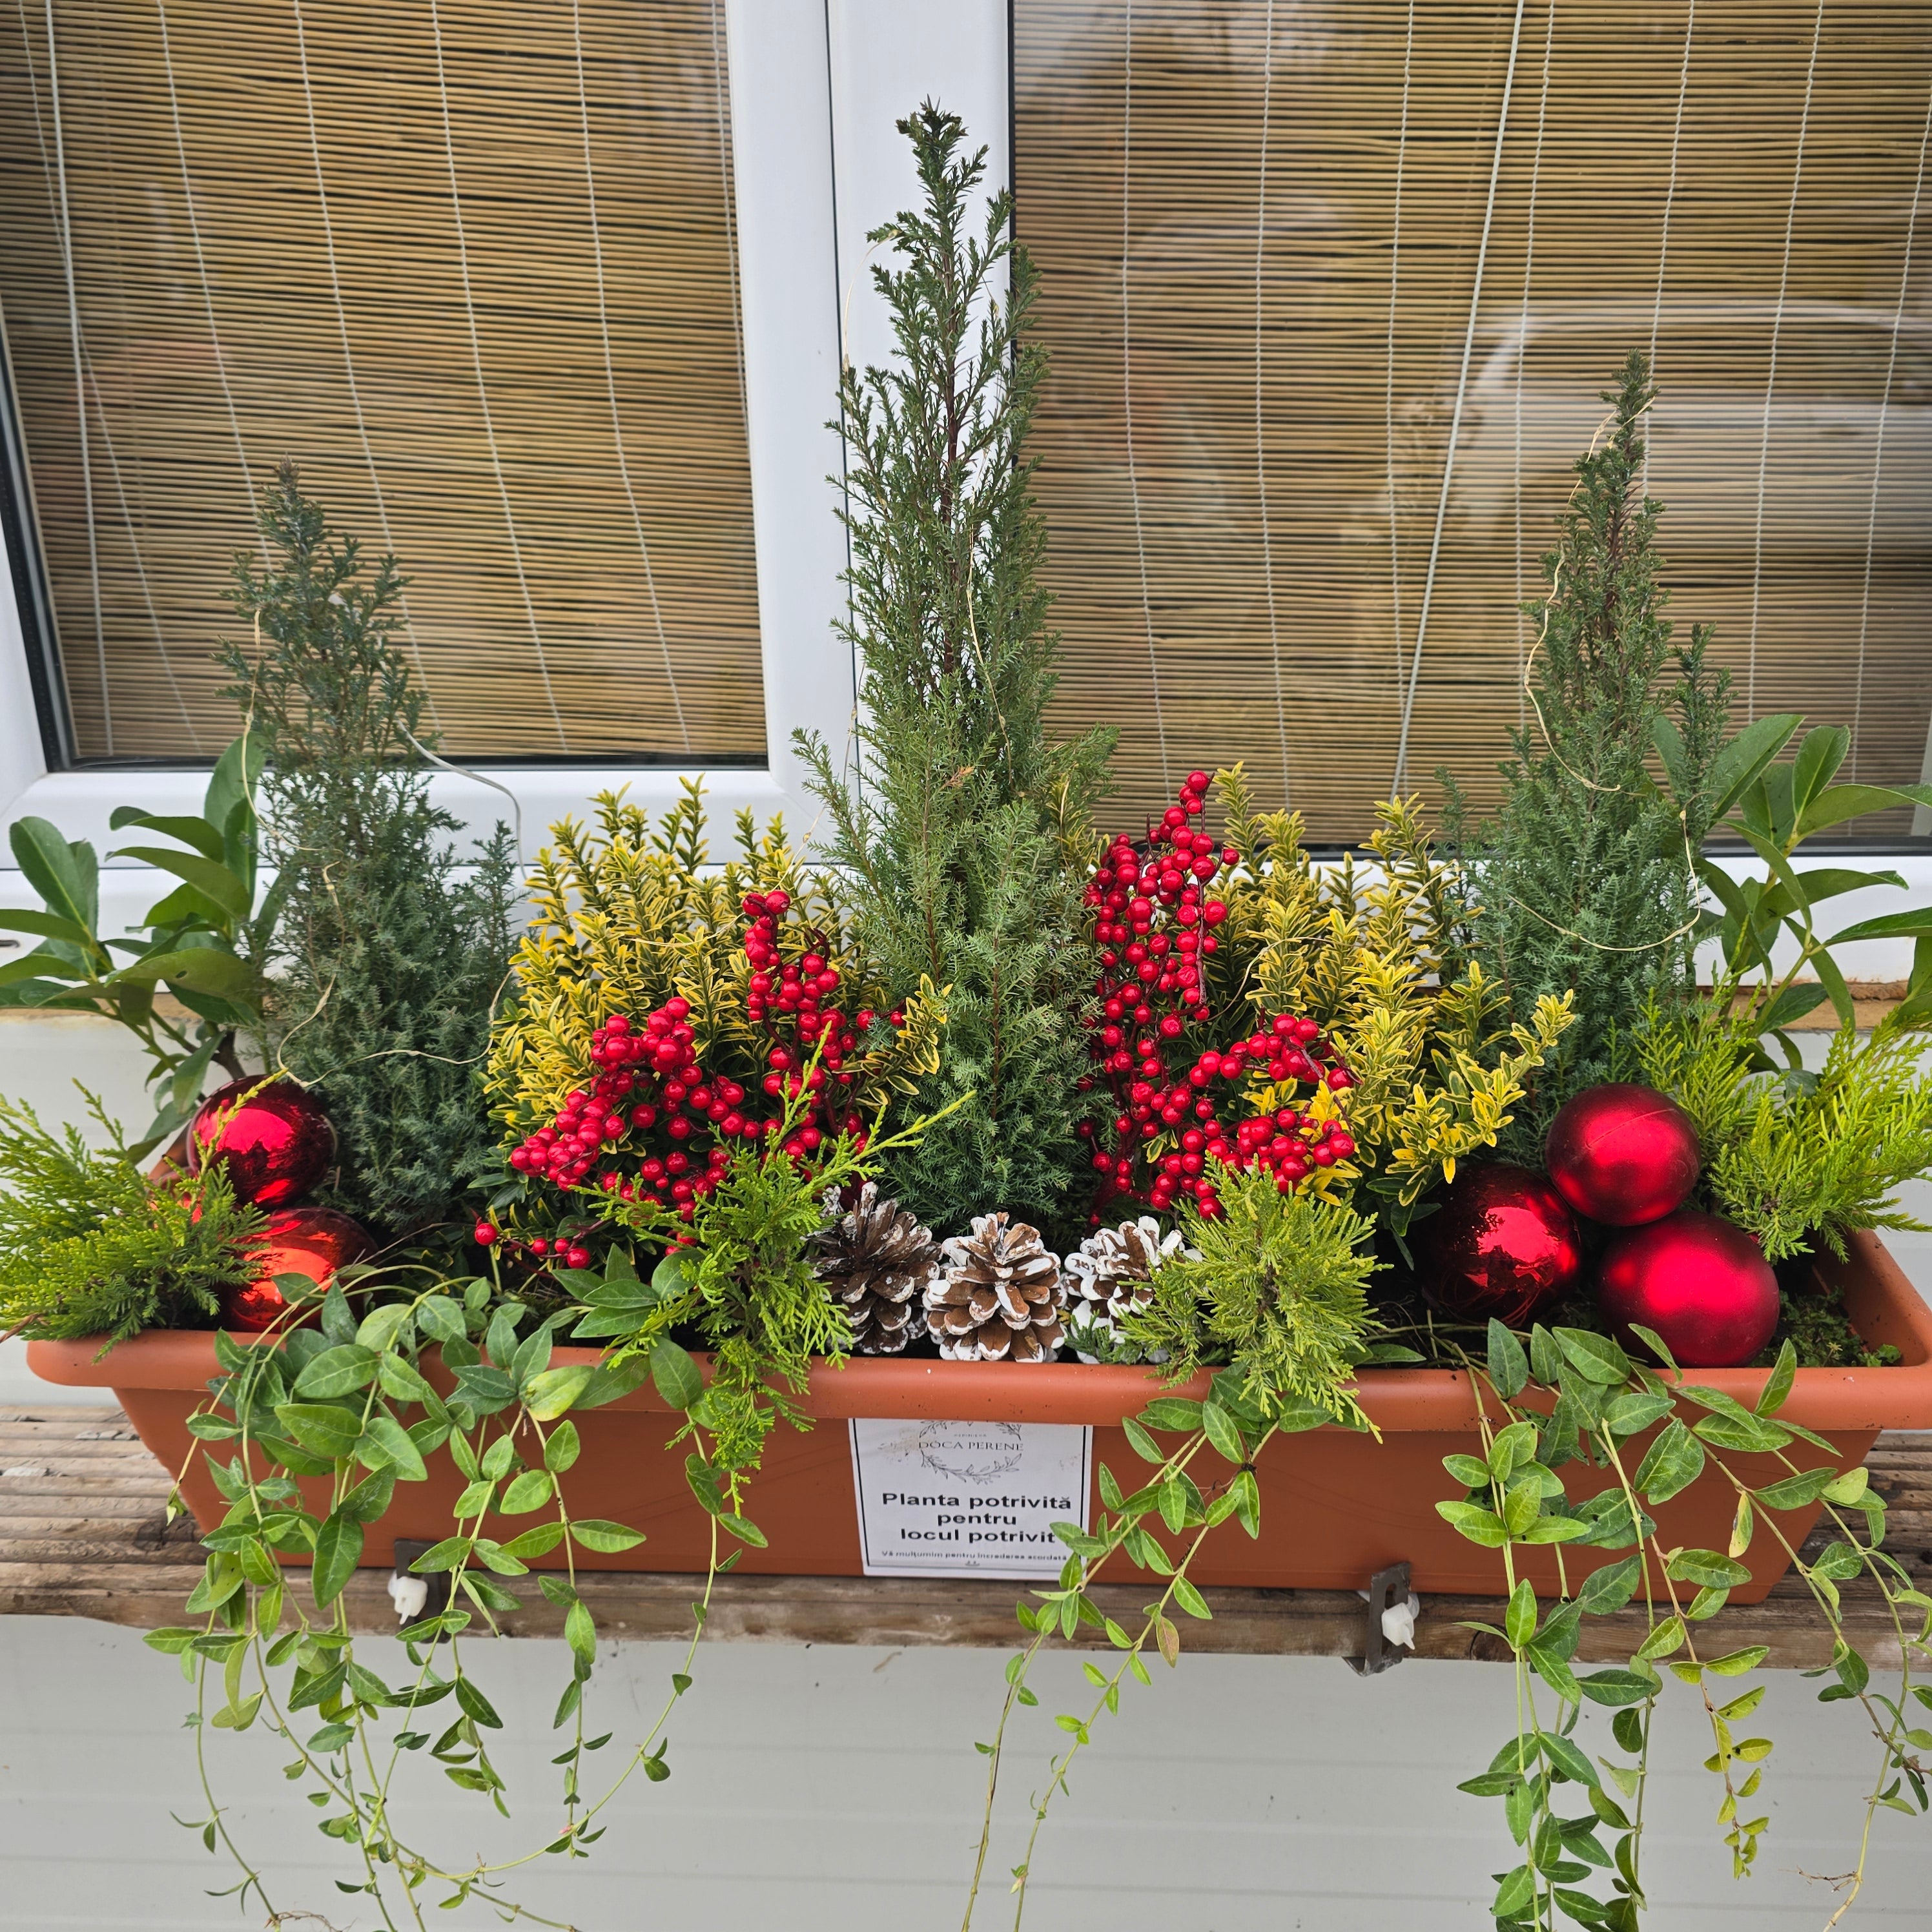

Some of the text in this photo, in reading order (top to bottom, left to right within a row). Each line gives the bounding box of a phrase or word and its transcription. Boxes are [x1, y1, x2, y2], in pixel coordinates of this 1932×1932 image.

[969, 1441, 1023, 1451] PERENE
[882, 1492, 1071, 1510] Planta potrivită
[938, 1514, 1016, 1526] pentru
[901, 1528, 1055, 1543] locul potrivit
